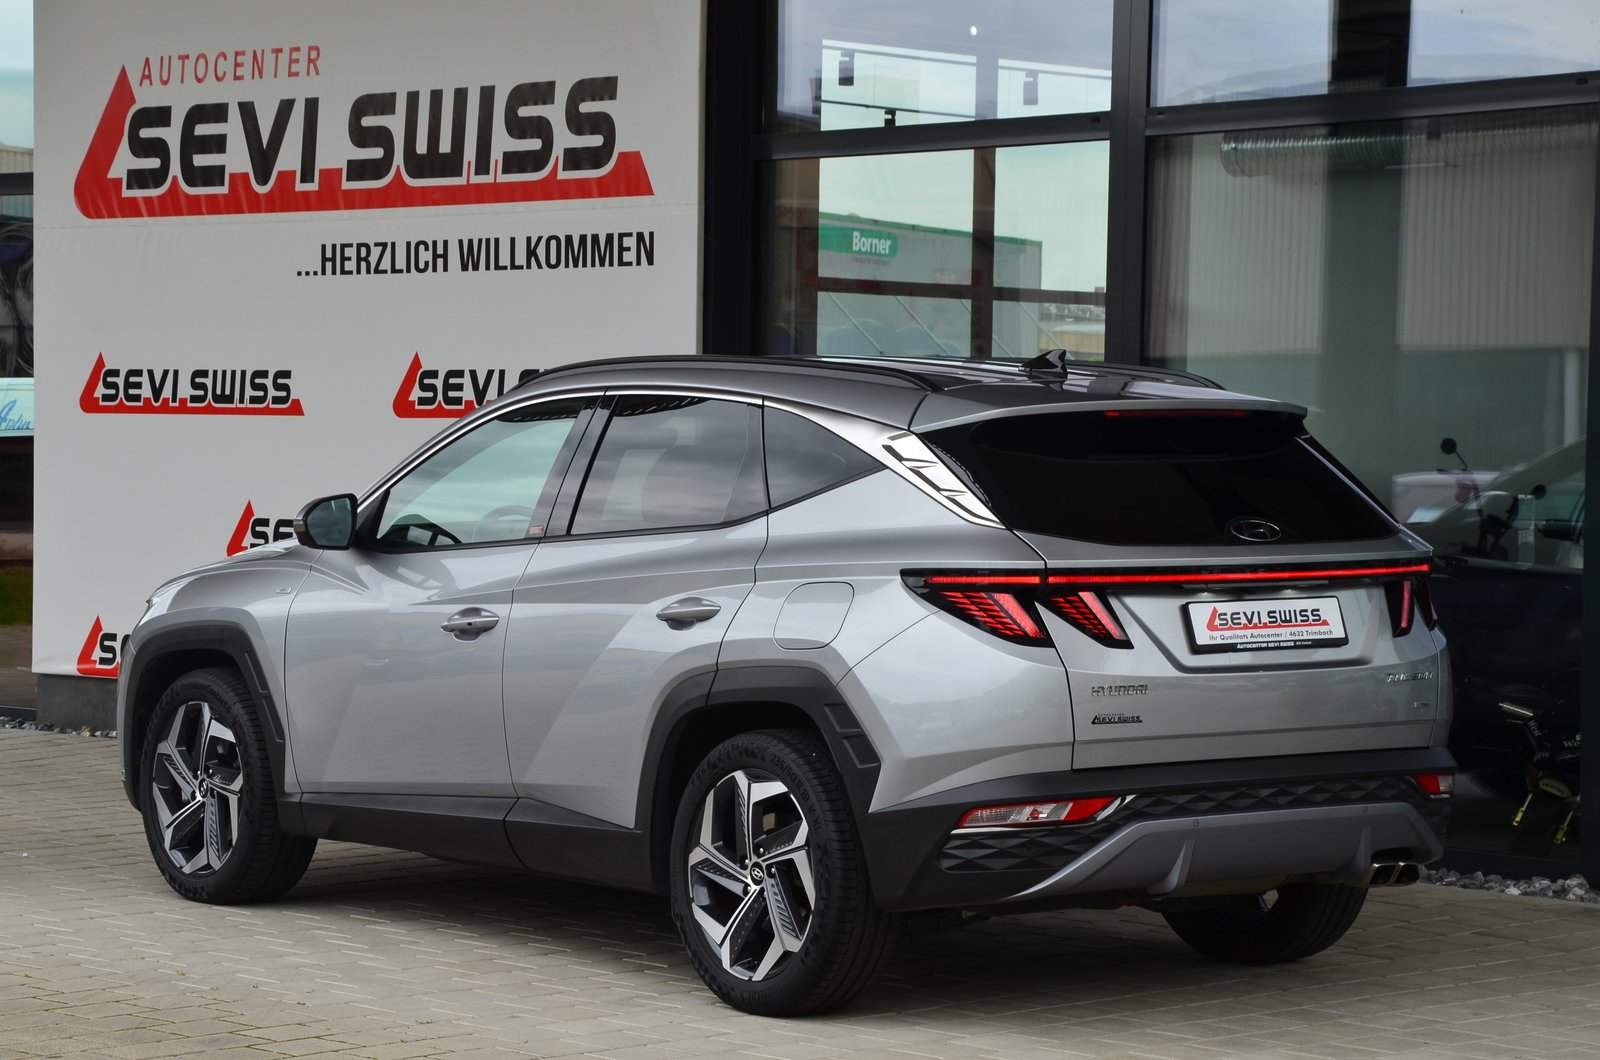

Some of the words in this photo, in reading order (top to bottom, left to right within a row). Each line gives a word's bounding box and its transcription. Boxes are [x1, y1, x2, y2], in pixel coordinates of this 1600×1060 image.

[139, 45, 321, 86] AUTOCENTER
[125, 96, 320, 191] SEVI
[345, 75, 619, 183] SWISS
[457, 230, 655, 272] WILLKOMMEN
[852, 230, 892, 255] Borner
[101, 368, 180, 404] SEVI
[189, 368, 292, 406] SWISS
[416, 368, 506, 407] SEVI
[1217, 610, 1262, 627] SEVI
[1267, 608, 1323, 625] SWISS
[1250, 632, 1283, 640] Autocenter
[1305, 629, 1333, 637] Trimbach
[1091, 684, 1149, 697] HYUNDAI
[770, 753, 797, 783] 235/50
